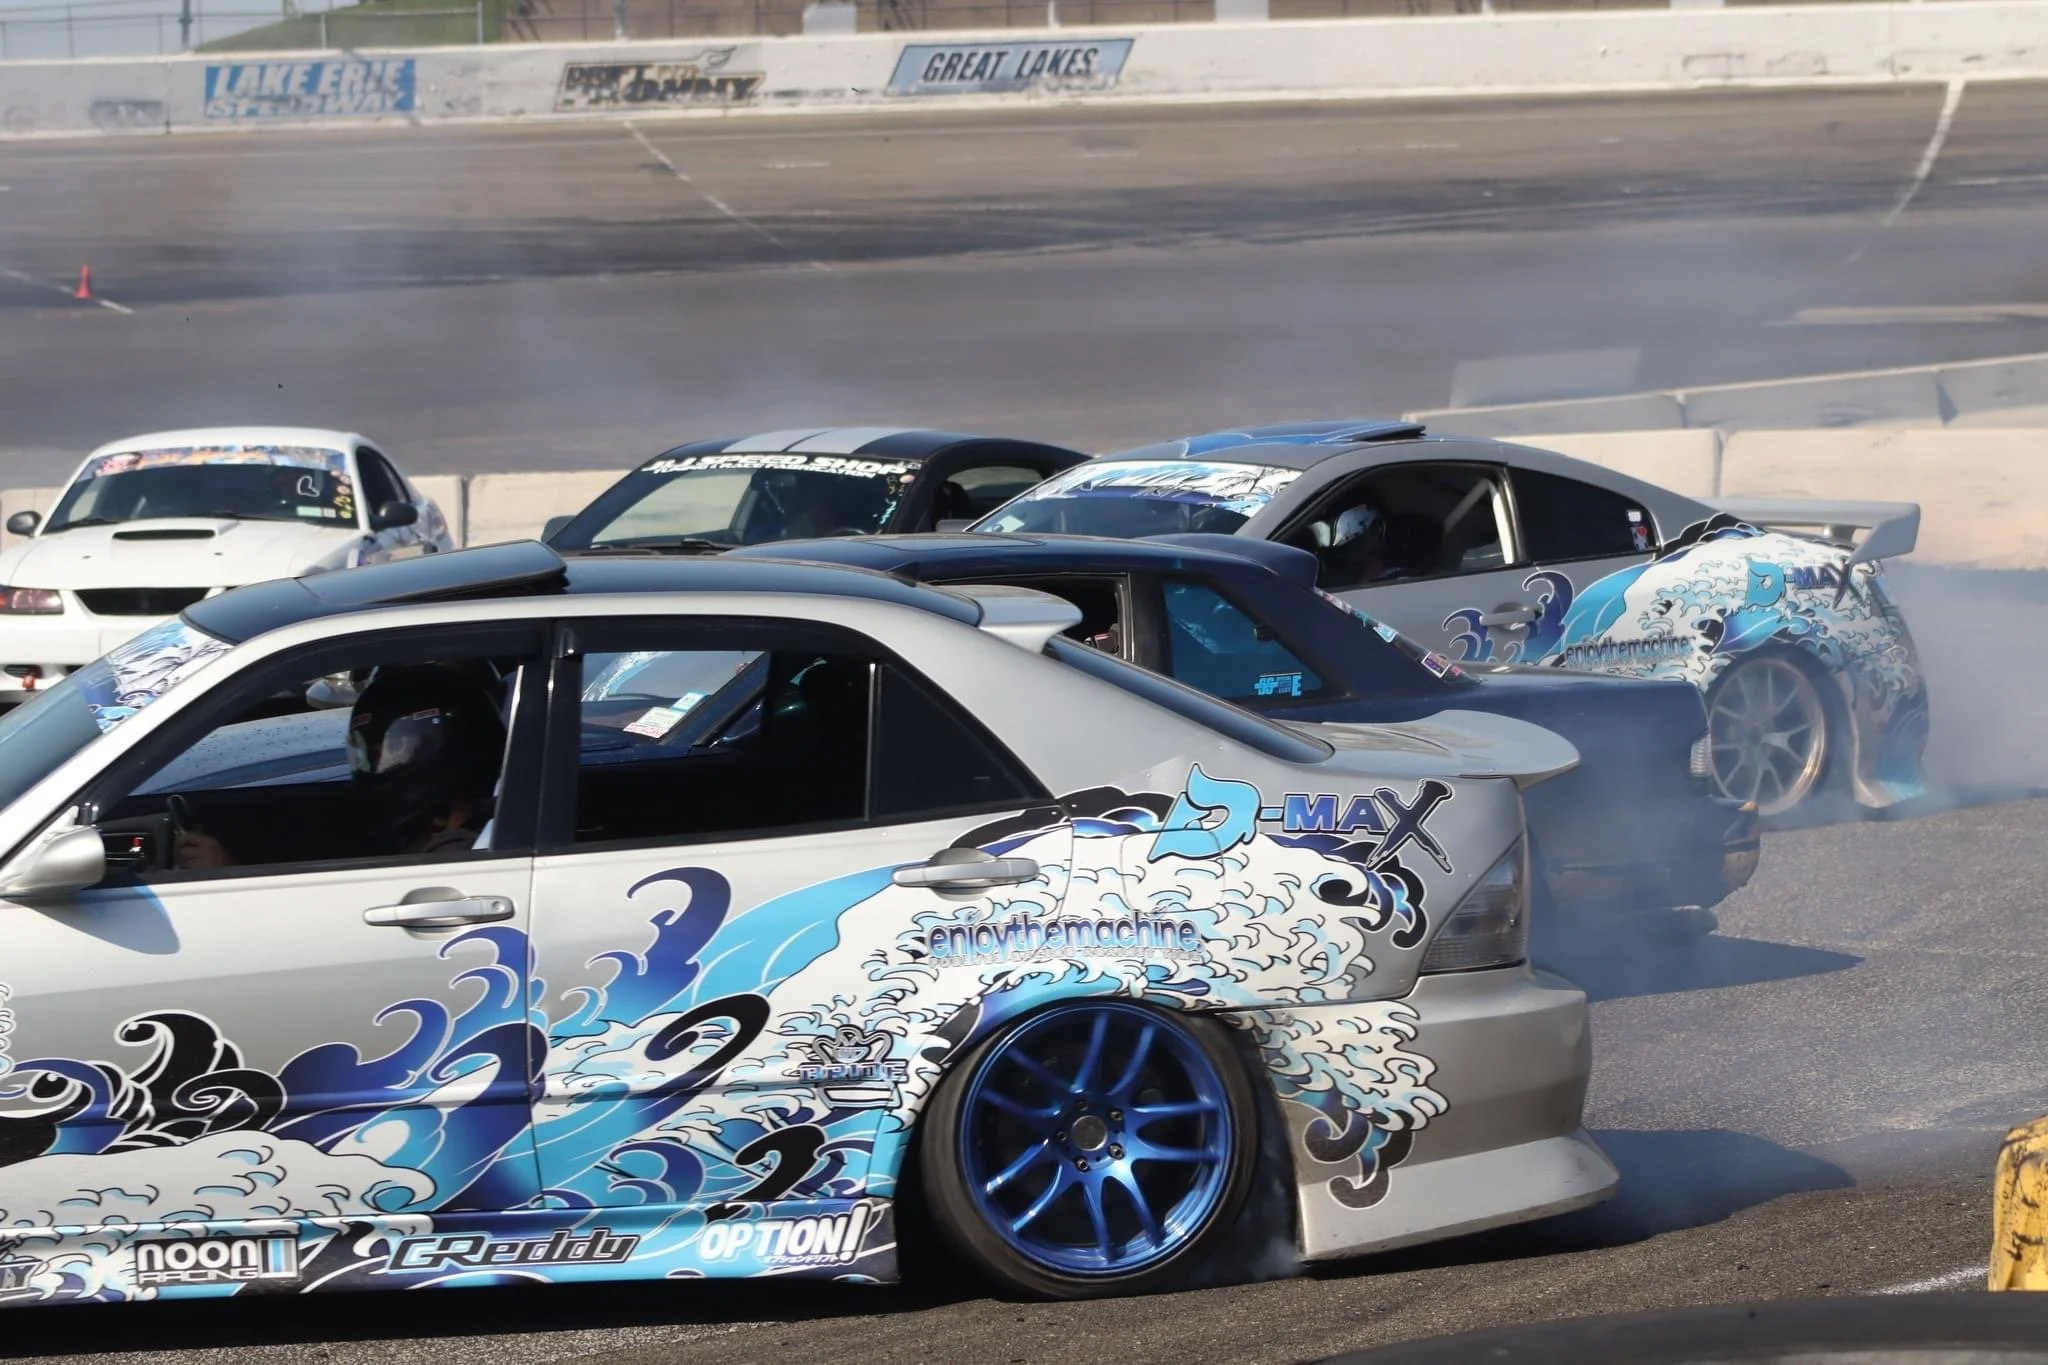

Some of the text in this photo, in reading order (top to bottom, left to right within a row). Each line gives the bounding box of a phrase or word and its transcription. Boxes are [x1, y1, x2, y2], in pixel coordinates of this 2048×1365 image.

[214, 61, 404, 97] LAKE ERIE
[922, 48, 1099, 82] GREAT LAKES
[700, 454, 808, 467] SPEED
[811, 456, 908, 475] SHOP
[1744, 556, 1868, 608] D-MAX
[1147, 762, 1454, 873] D-MAX
[700, 1205, 870, 1262] OPTION!
[139, 1266, 259, 1284] RACING
